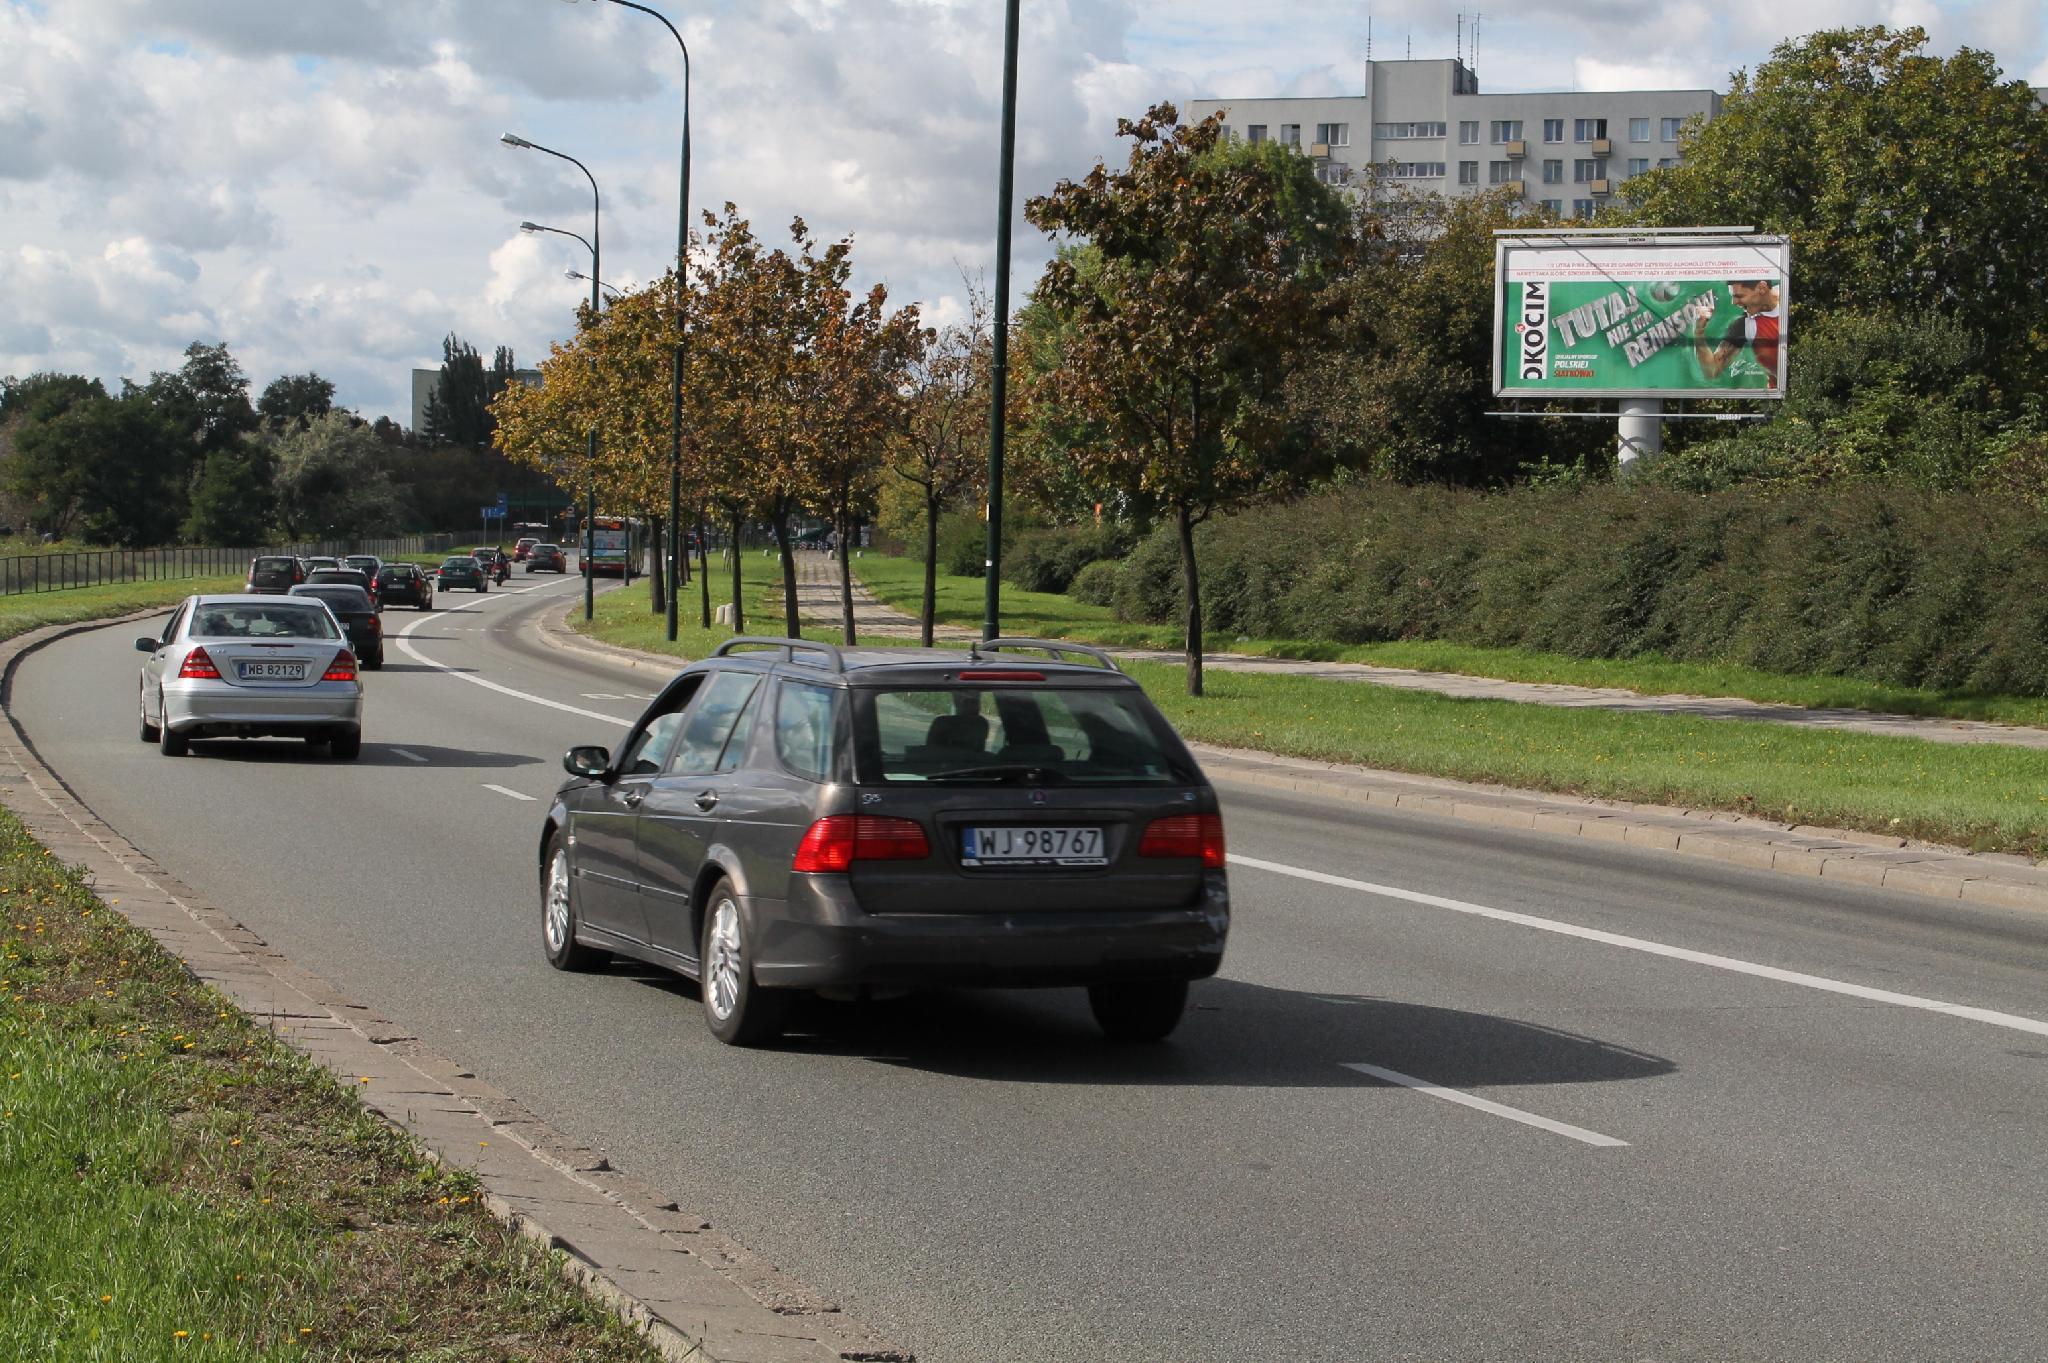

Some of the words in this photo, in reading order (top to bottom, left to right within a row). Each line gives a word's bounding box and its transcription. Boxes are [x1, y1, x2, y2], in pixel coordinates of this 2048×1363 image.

[1523, 281, 1546, 379] OKOCIM
[1552, 285, 1639, 348] TUTAJ
[1606, 322, 1632, 348] NIE
[1631, 310, 1654, 333] MA
[1554, 360, 1589, 368] POLSKIEJ
[248, 664, 263, 675] WB
[267, 664, 302, 675] 82129
[979, 830, 1012, 855] WJ
[1023, 830, 1099, 855] 98767
